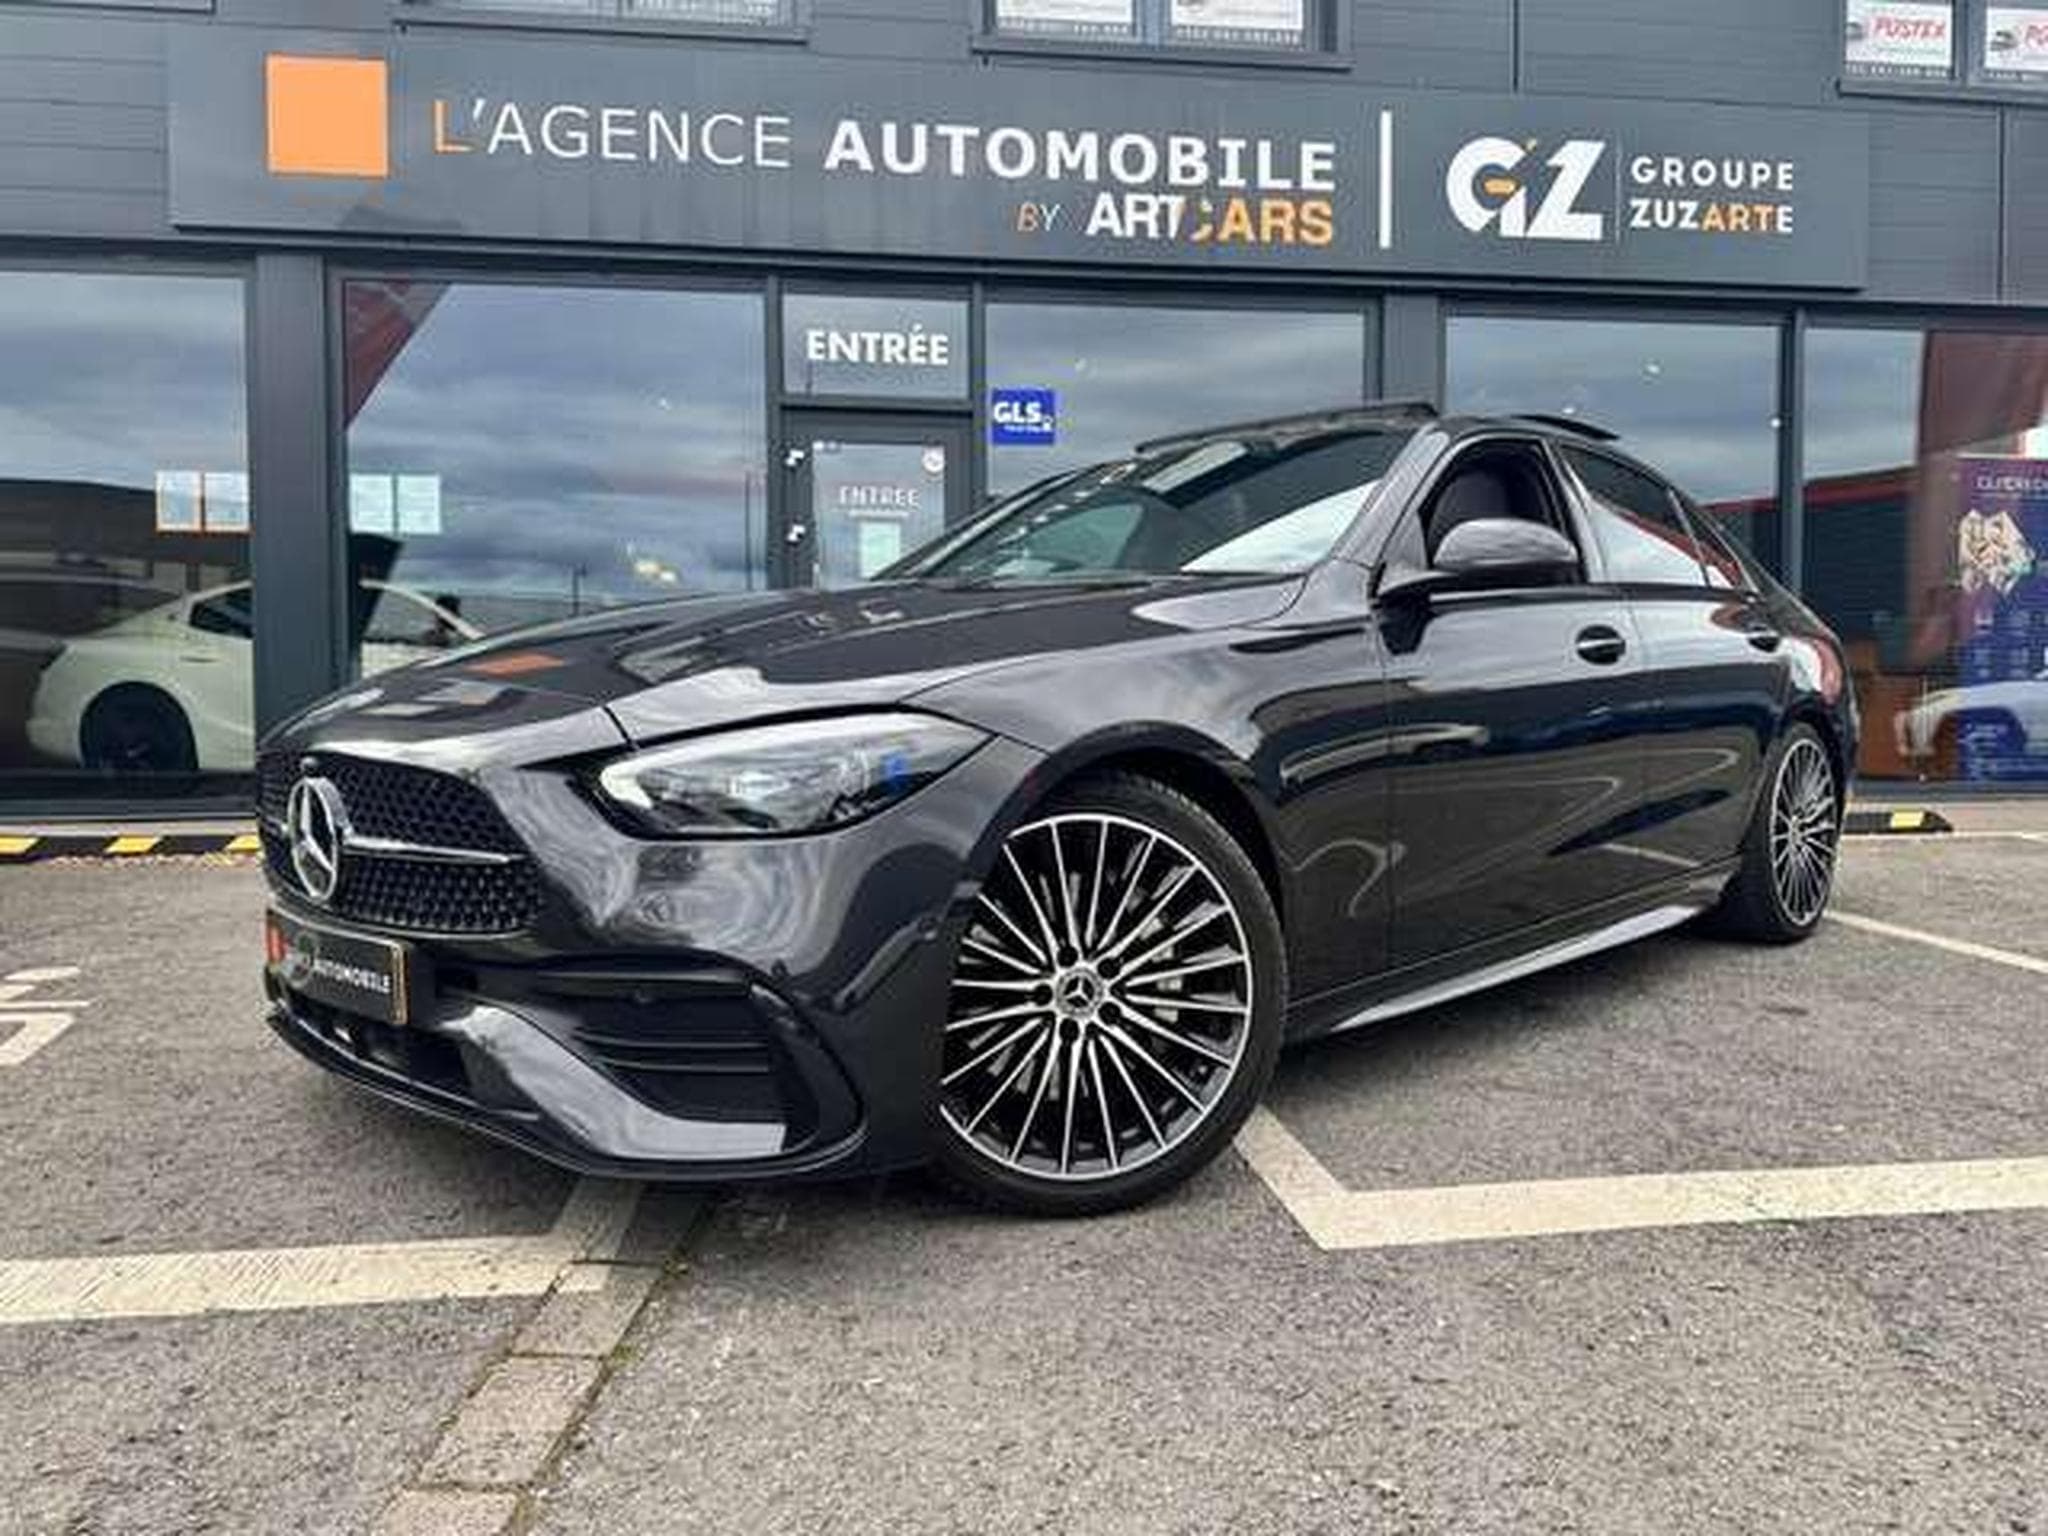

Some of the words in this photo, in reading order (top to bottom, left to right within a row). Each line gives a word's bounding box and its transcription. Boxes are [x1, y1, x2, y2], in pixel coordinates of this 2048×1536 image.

[433, 99, 791, 168] L'AGENCE
[823, 119, 1336, 191] AUTOMOBILE
[1630, 156, 1794, 190] GROUPE
[1016, 202, 1061, 232] BY
[1630, 198, 1794, 233] ZUZARTE
[806, 324, 949, 365] ENTRÉE
